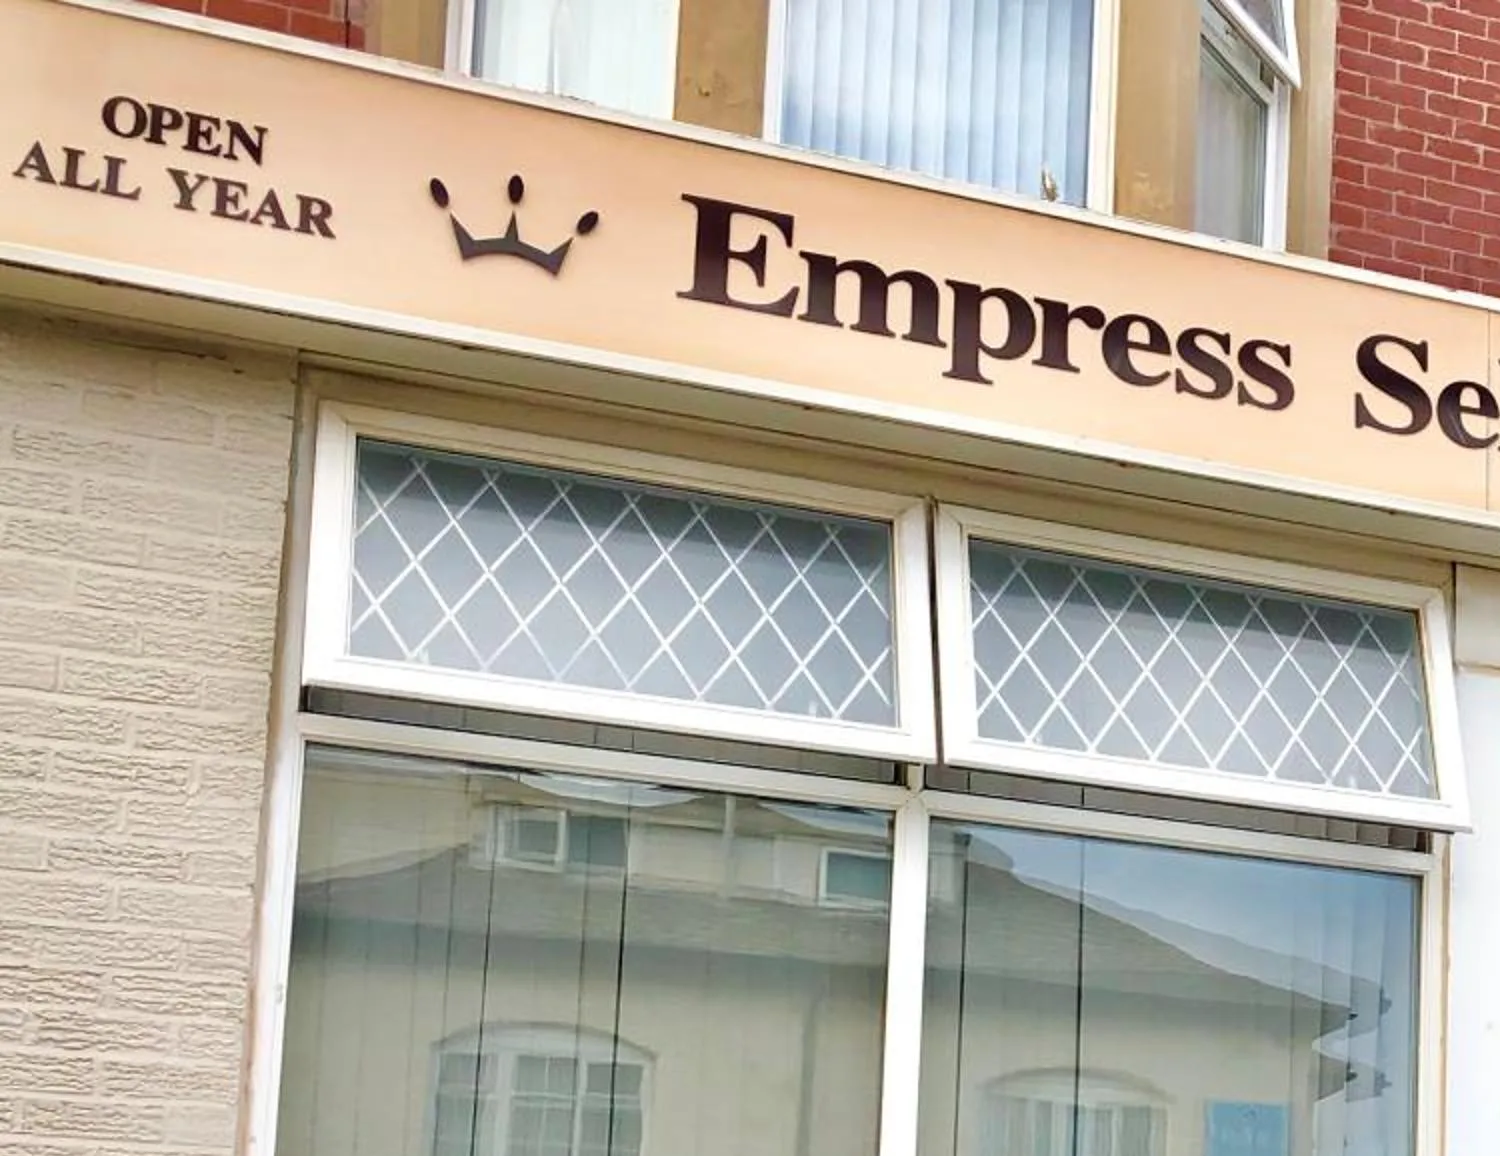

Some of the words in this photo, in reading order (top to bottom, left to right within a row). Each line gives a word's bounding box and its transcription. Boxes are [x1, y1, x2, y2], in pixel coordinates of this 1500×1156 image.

[101, 95, 268, 167] OPEN
[12, 139, 142, 201] ALL
[166, 166, 337, 240] YEAR
[676, 193, 1295, 412] Empress
